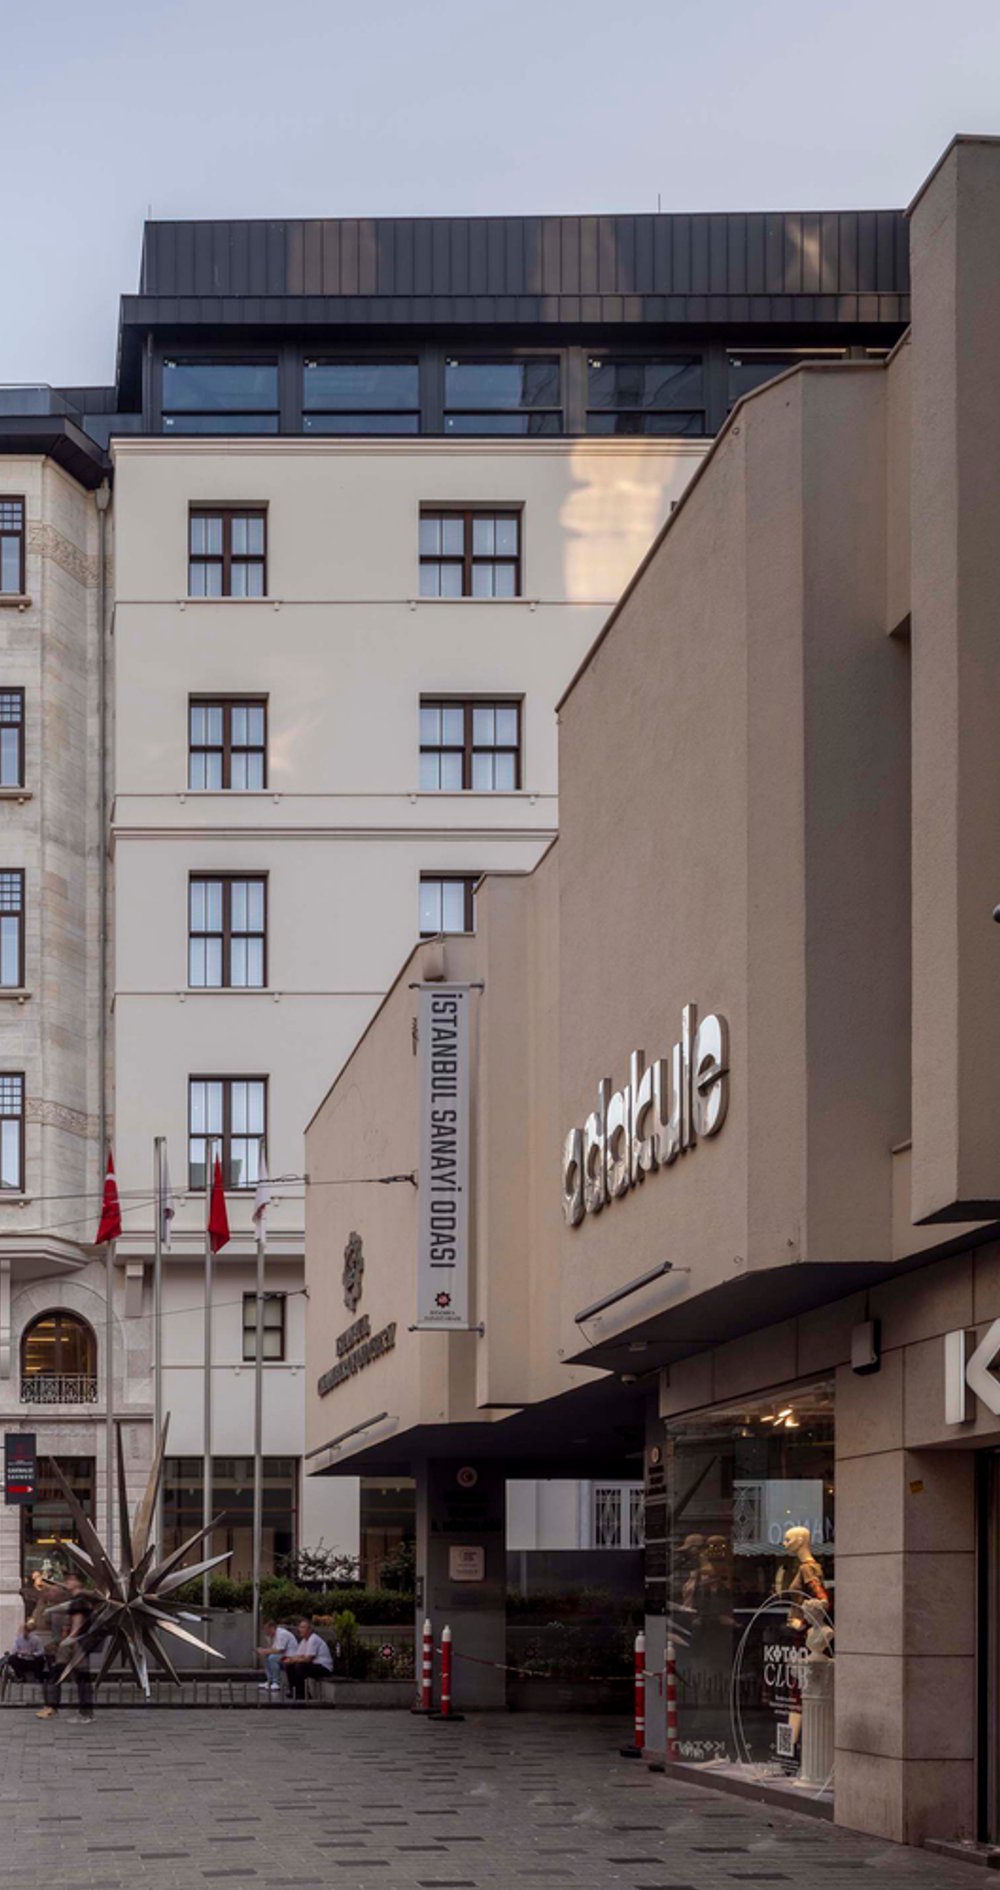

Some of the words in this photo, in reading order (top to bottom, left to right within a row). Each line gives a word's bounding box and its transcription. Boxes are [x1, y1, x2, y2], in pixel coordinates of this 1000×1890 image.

[431, 993, 463, 1103] İSTANBUL
[431, 1108, 462, 1192] SANAYİ
[430, 1200, 456, 1268] ODASI
